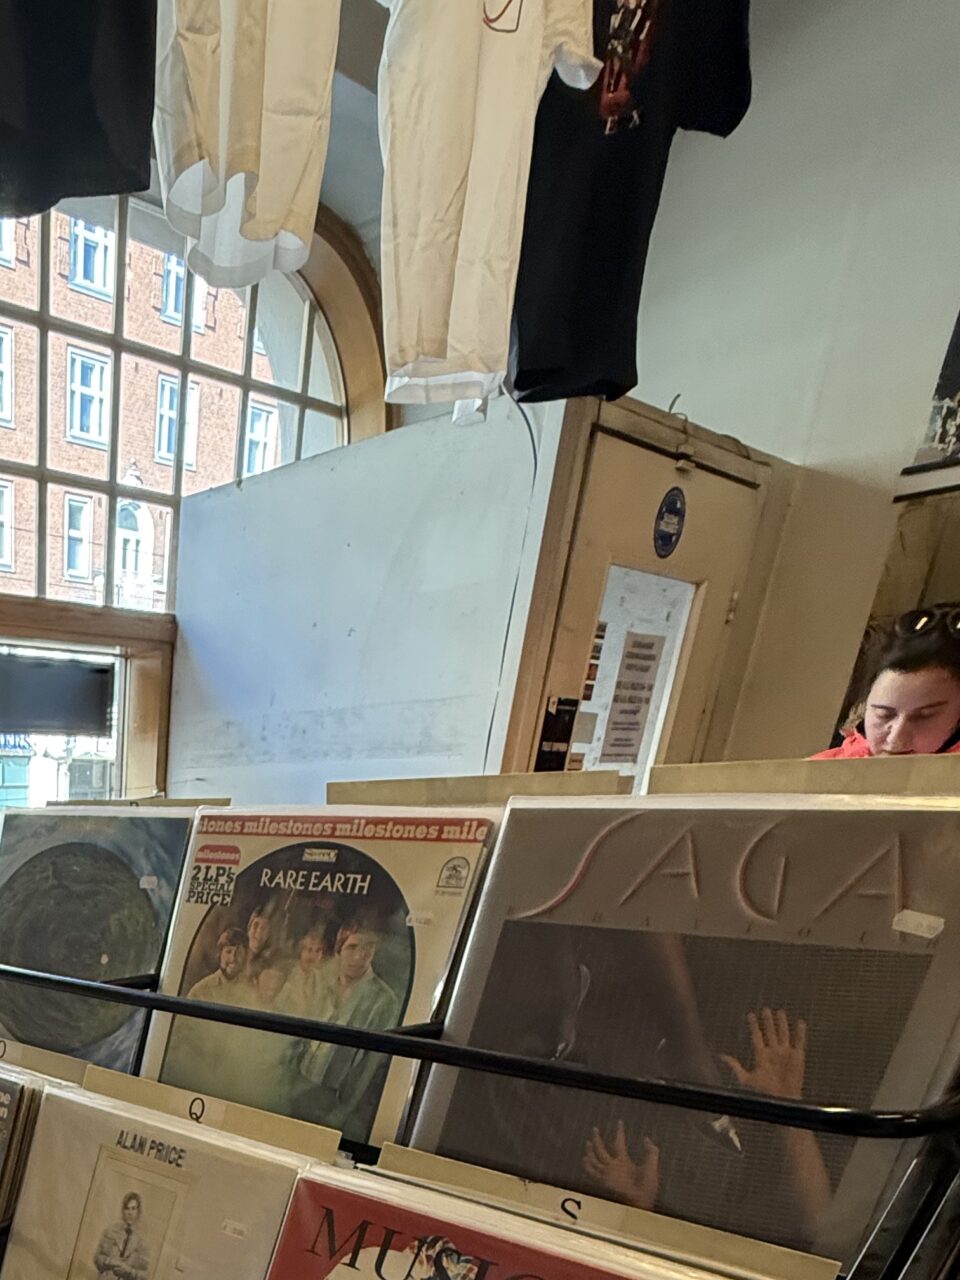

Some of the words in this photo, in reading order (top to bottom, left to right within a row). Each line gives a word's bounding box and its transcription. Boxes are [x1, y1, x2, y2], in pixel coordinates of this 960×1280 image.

[243, 817, 334, 836] milestones
[335, 818, 440, 840] milestones
[192, 865, 201, 881] 2
[512, 809, 908, 922] SAGA
[189, 881, 233, 894] SPECIAL
[259, 867, 307, 891] RARE
[308, 870, 371, 895] EARTH
[185, 889, 232, 907] PRICE
[188, 1096, 206, 1124] Q
[116, 1130, 148, 1156] ALAN
[148, 1139, 187, 1168] PRICE
[560, 1197, 582, 1221] S
